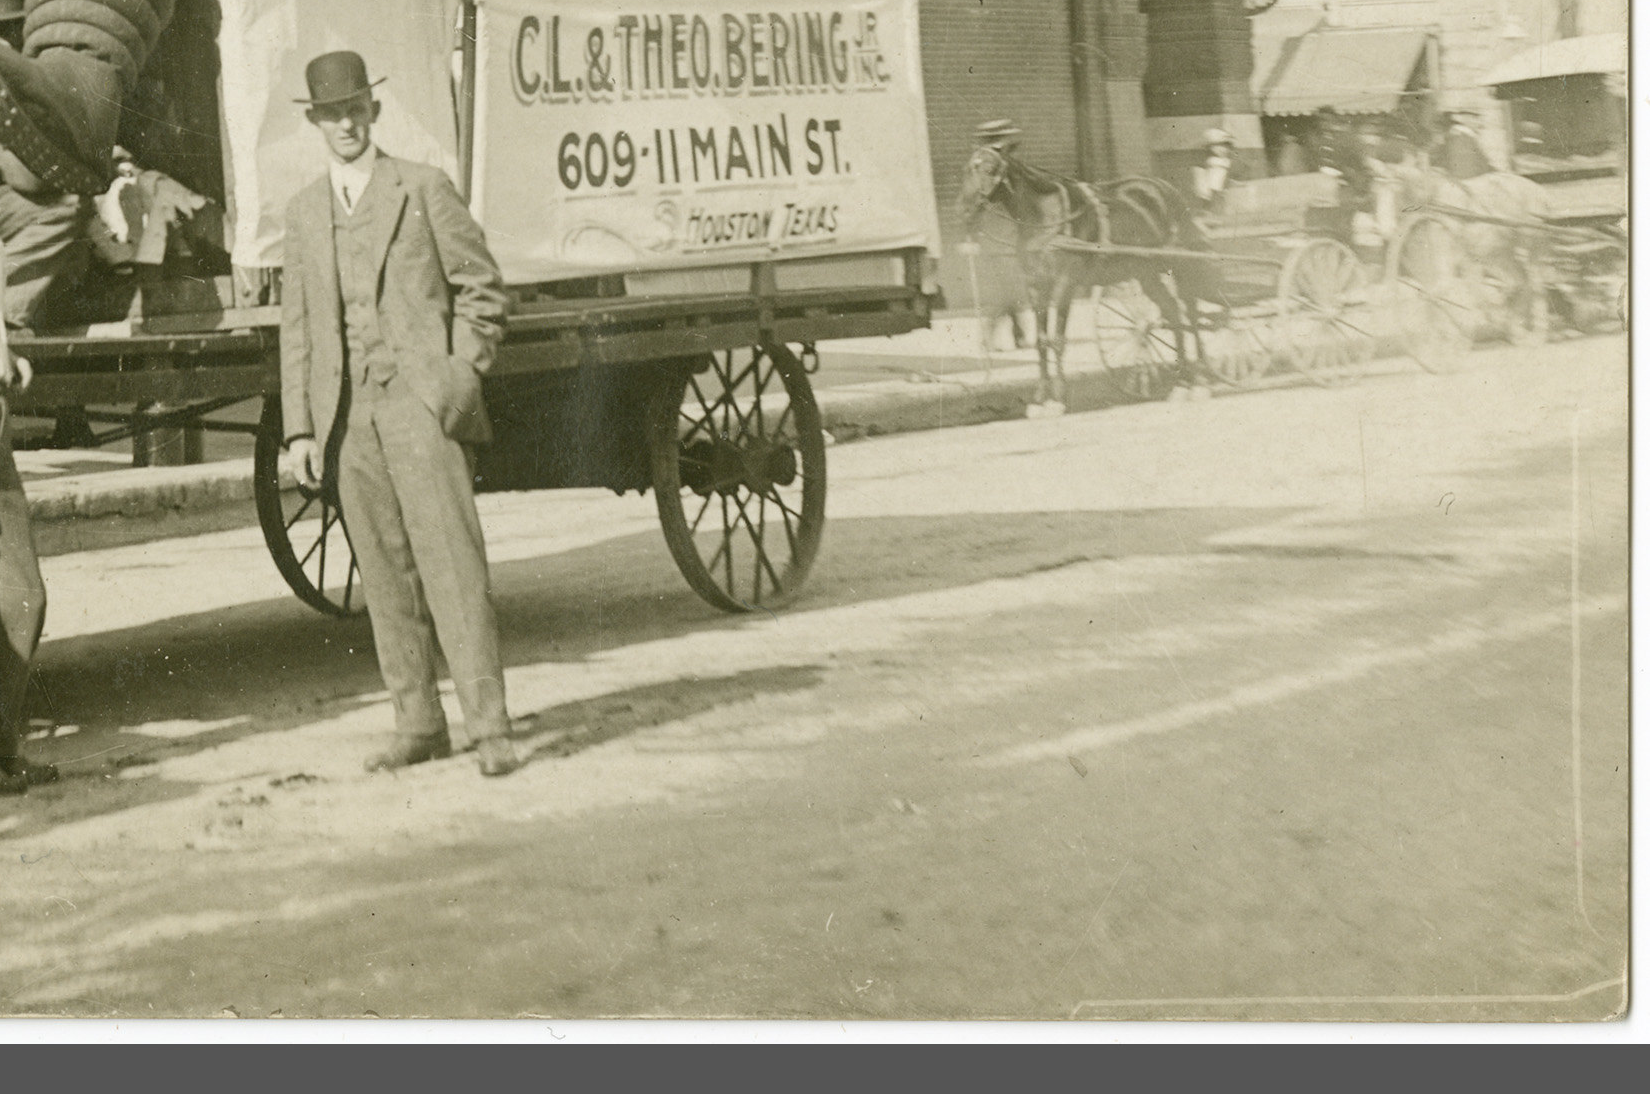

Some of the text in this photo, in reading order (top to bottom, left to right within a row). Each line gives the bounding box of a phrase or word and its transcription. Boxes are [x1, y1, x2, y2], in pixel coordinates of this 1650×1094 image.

[721, 12, 848, 88] BERING
[689, 113, 792, 182] MAIN
[805, 118, 850, 175] ST.
[685, 204, 839, 246] HOUSTON TEXAS
